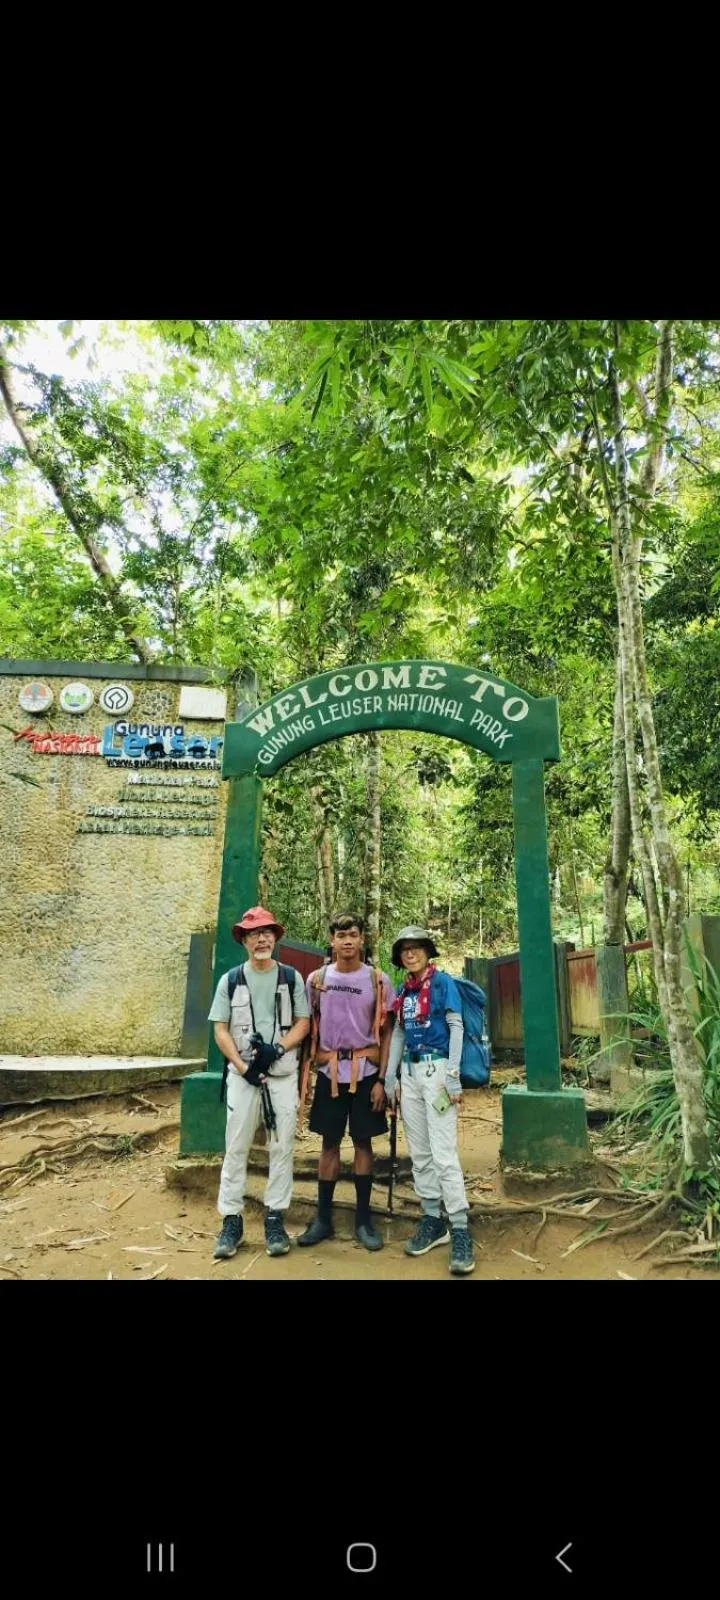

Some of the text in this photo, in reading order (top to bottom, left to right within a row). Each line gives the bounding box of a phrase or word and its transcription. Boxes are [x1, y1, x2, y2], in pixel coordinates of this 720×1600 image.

[246, 665, 529, 738] WELCOME TO
[257, 693, 514, 765] GUNUNG LEUSER NATIONAL PARK
